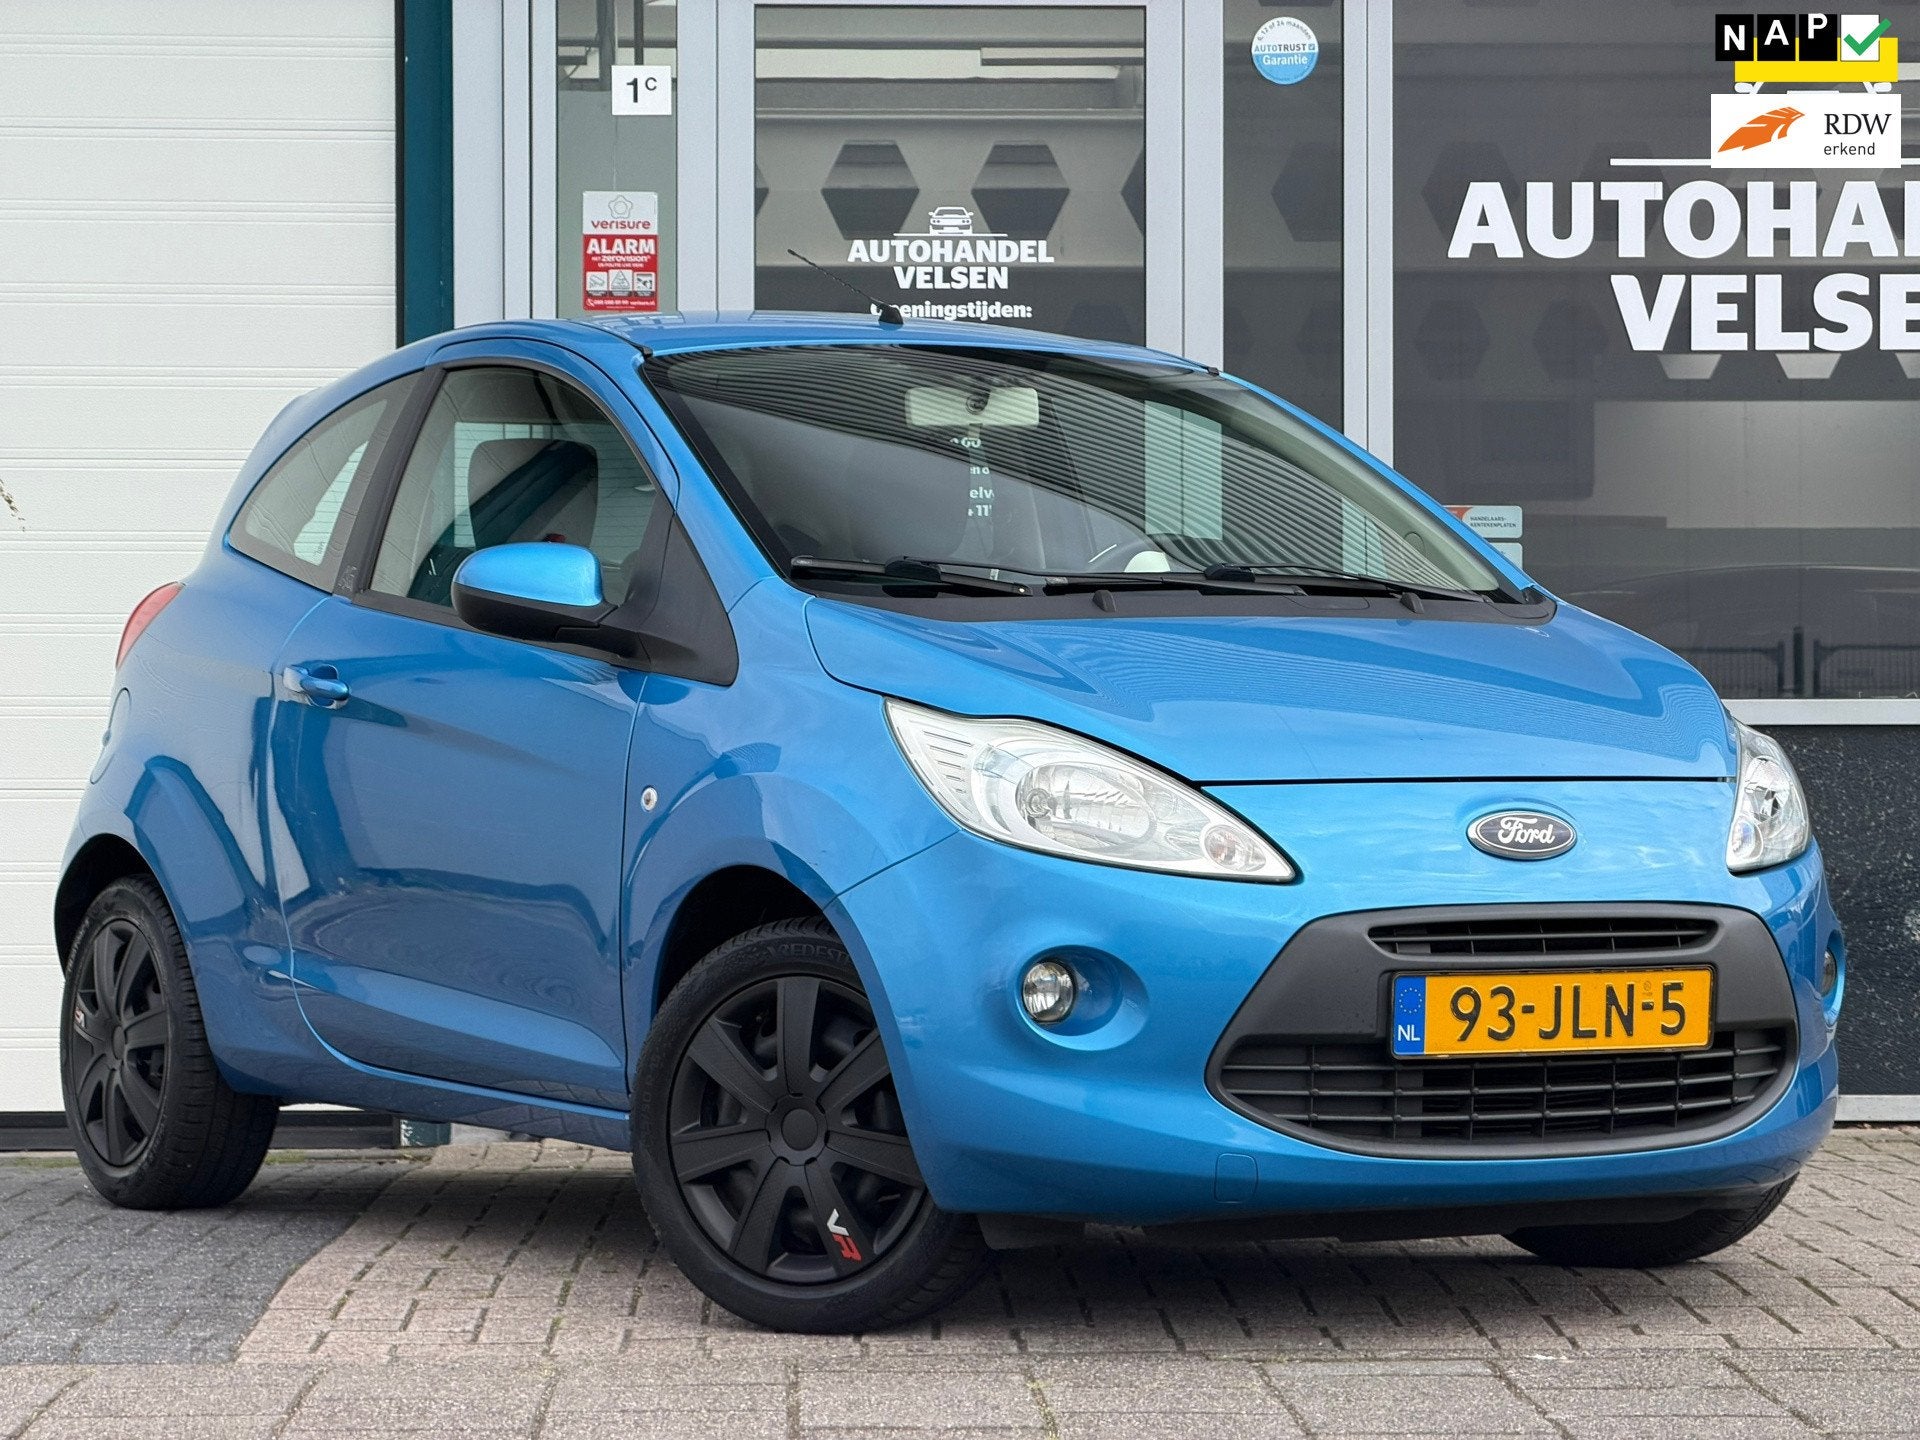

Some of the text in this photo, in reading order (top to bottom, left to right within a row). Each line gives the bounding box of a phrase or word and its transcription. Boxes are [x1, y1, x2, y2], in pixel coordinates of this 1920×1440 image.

[1254, 43, 1307, 52] AUTOTRUST
[1262, 54, 1309, 66] Garantie
[591, 220, 651, 230] verisure
[1447, 180, 1920, 259] AUTOHA
[586, 238, 656, 255] ALARM
[847, 239, 1055, 263] AUTOHANDEL
[893, 266, 1009, 290] VELSEN
[870, 300, 1033, 321] eningstijden:
[1497, 816, 1556, 844] Ford
[1449, 981, 1686, 1042] 93-JLN-5
[1397, 1023, 1421, 1042] NL
